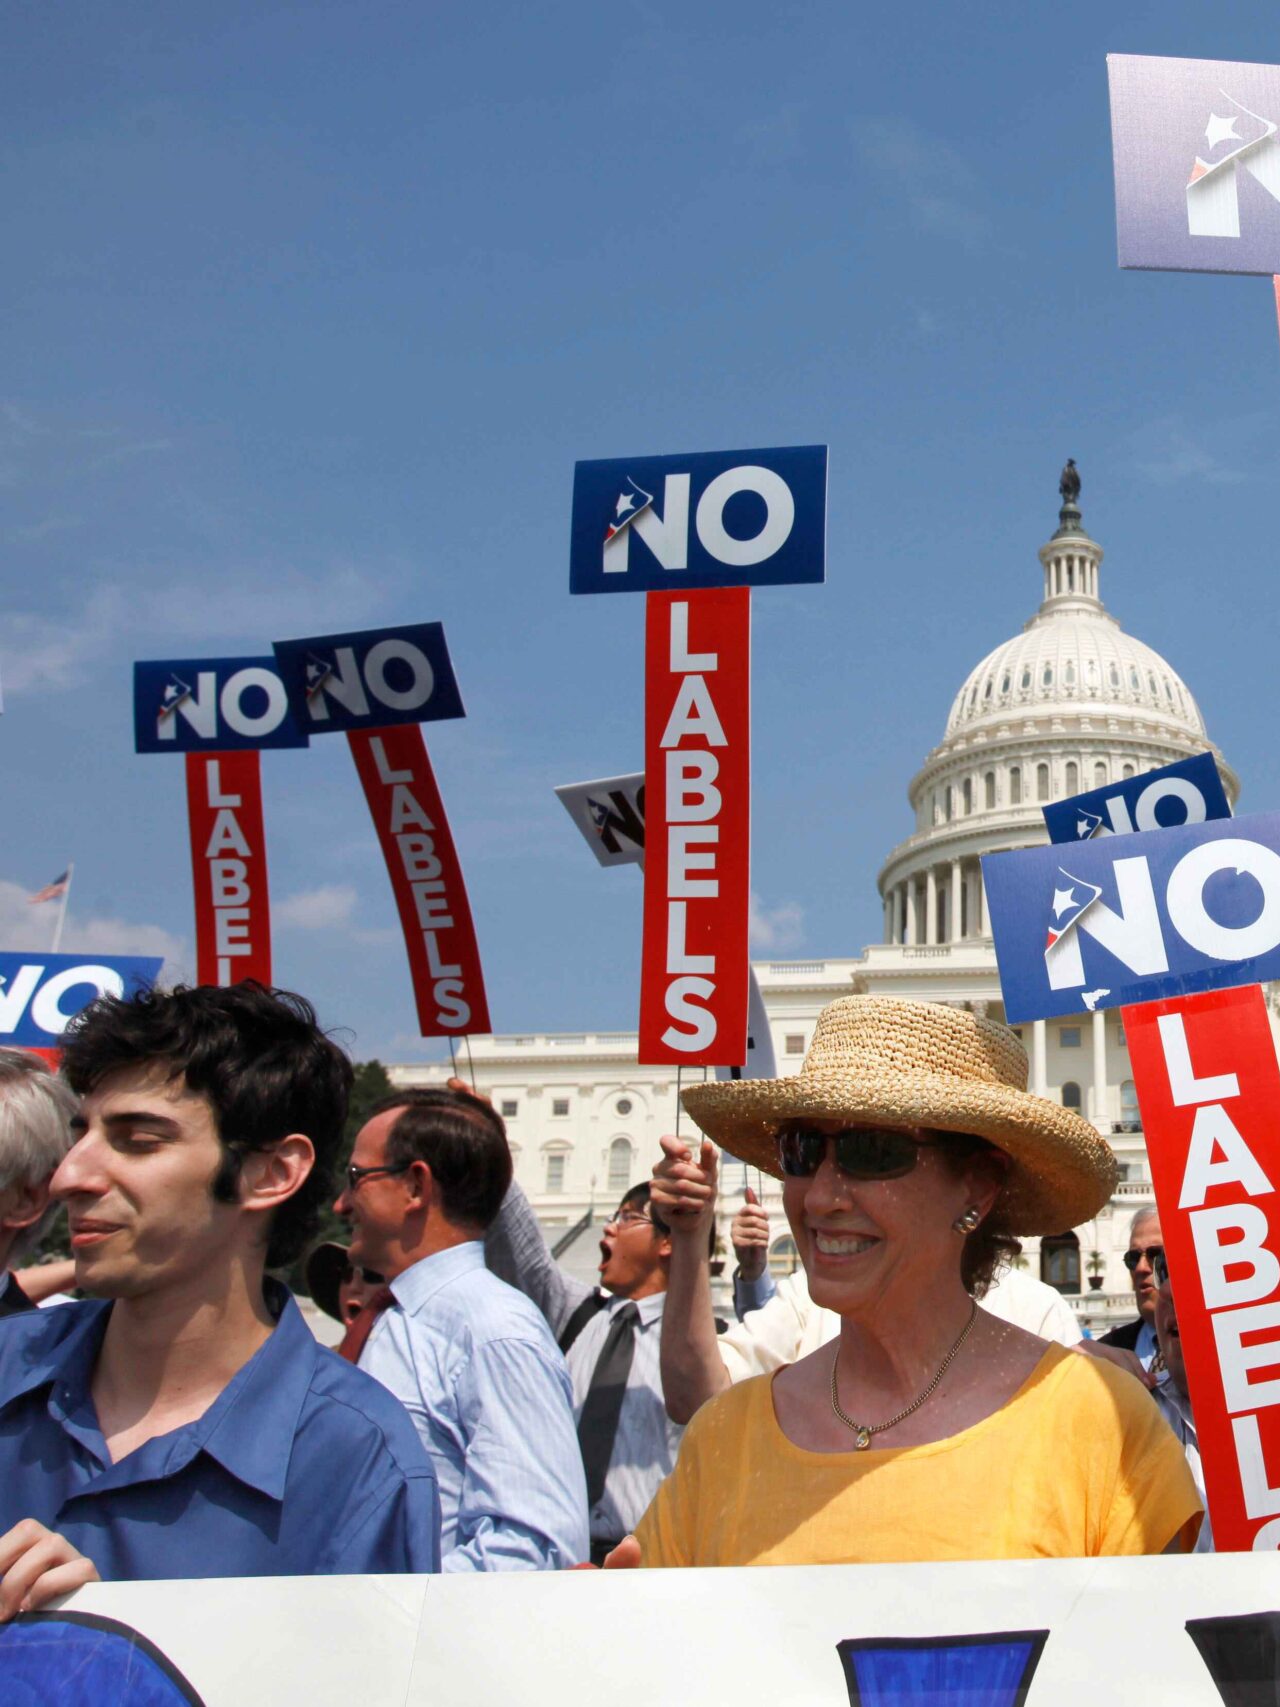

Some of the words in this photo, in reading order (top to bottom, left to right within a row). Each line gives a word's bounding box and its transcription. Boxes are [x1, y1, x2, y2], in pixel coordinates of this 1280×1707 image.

[603, 465, 795, 573] NO
[157, 667, 289, 740] NO
[306, 639, 434, 721] NO
[660, 601, 729, 1052] LABELS
[369, 737, 471, 1029] LABELS
